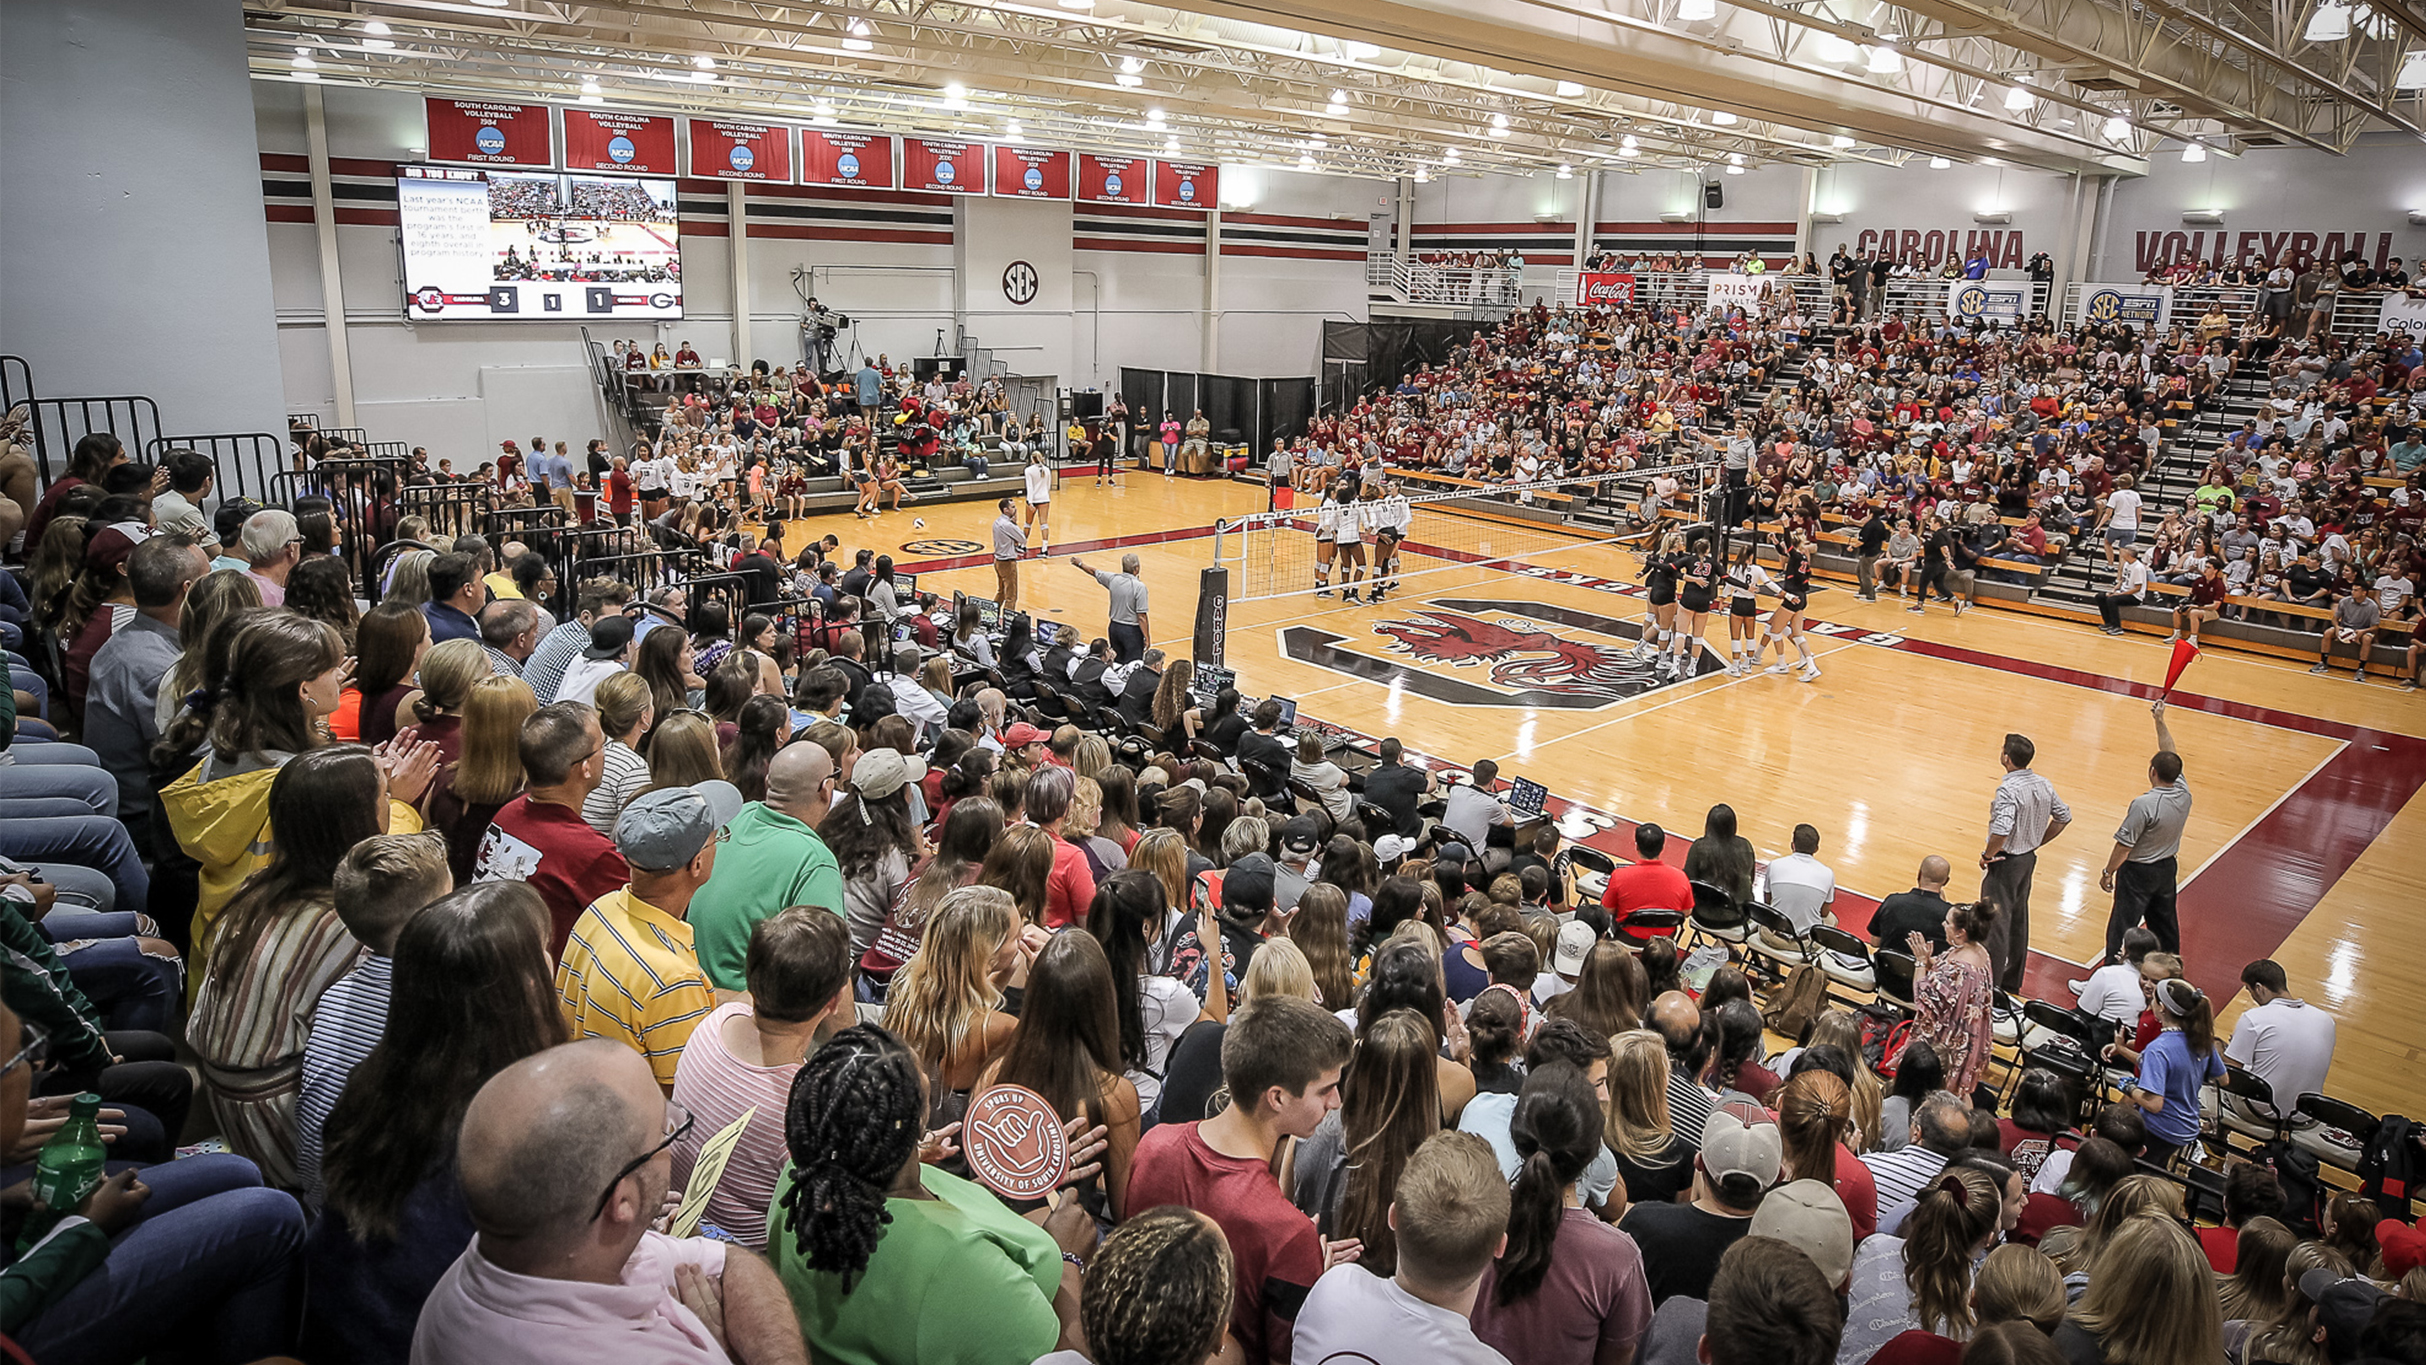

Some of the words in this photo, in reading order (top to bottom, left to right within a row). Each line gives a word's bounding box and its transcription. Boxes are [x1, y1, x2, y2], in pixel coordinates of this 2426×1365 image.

[454, 101, 481, 110] SOUTH
[482, 102, 522, 113] CAROLINA
[464, 109, 514, 120] VOLLEYBALL
[589, 112, 614, 121] SOUTH
[614, 114, 651, 123] CAROLINA
[597, 120, 643, 130] VOLLEYBALL
[735, 125, 768, 133] CAROLINA
[721, 130, 761, 140] VOLLEYBALL
[822, 132, 842, 140] SOUTH
[842, 134, 872, 142] CAROLINA
[478, 139, 505, 149] NCAA
[829, 139, 866, 148] VOLLEYBALL
[940, 142, 968, 150] CAROLINA
[611, 148, 635, 158] NCAA
[928, 148, 962, 156] VOLLEYBALL
[467, 153, 488, 162] FIRST
[488, 155, 515, 163] ROUND
[732, 157, 753, 166] NCAA
[1018, 155, 1049, 163] VOLLEYBALL
[595, 162, 623, 171] SECOND
[624, 163, 649, 172] ROUND
[841, 165, 859, 173] NCAA
[405, 167, 423, 178] DID
[424, 168, 445, 179] YOU
[446, 169, 479, 180] KNOW?
[717, 170, 743, 178] SECOND
[743, 171, 766, 179] ROUND
[937, 172, 954, 180] NCAA
[403, 195, 423, 203] Last
[426, 197, 453, 205] year's
[456, 197, 484, 205] NCAA
[403, 204, 458, 213] tournament
[460, 206, 486, 214] berth
[407, 223, 454, 233] program's
[456, 223, 474, 231] first
[411, 240, 441, 249] eighth
[1857, 229, 2023, 270] CAROLINA
[410, 249, 451, 258] program
[2135, 231, 2394, 274] VOLLEYBALL
[1006, 264, 1035, 302] SEC
[452, 295, 485, 303] CAROLINA
[499, 292, 510, 306] 3
[549, 296, 557, 309] 1
[594, 293, 603, 307] 1
[1961, 289, 1986, 314] SEC
[1988, 294, 2018, 303] ESPN
[2122, 298, 2157, 309] ESPN
[1986, 304, 2018, 314] NETWORK
[2093, 292, 2120, 321] SEC
[2121, 310, 2155, 320] NETWORK
[2386, 317, 2426, 330] Colo
[1693, 562, 1712, 576] 23
[984, 1094, 1009, 1110] SPURS
[1011, 1093, 1025, 1104] UP
[973, 1142, 1016, 1189] UNIVERSITY
[1017, 1180, 1030, 1190] OF
[1032, 1167, 1057, 1188] SOUTH
[1047, 1121, 1062, 1168] CAROLINA
